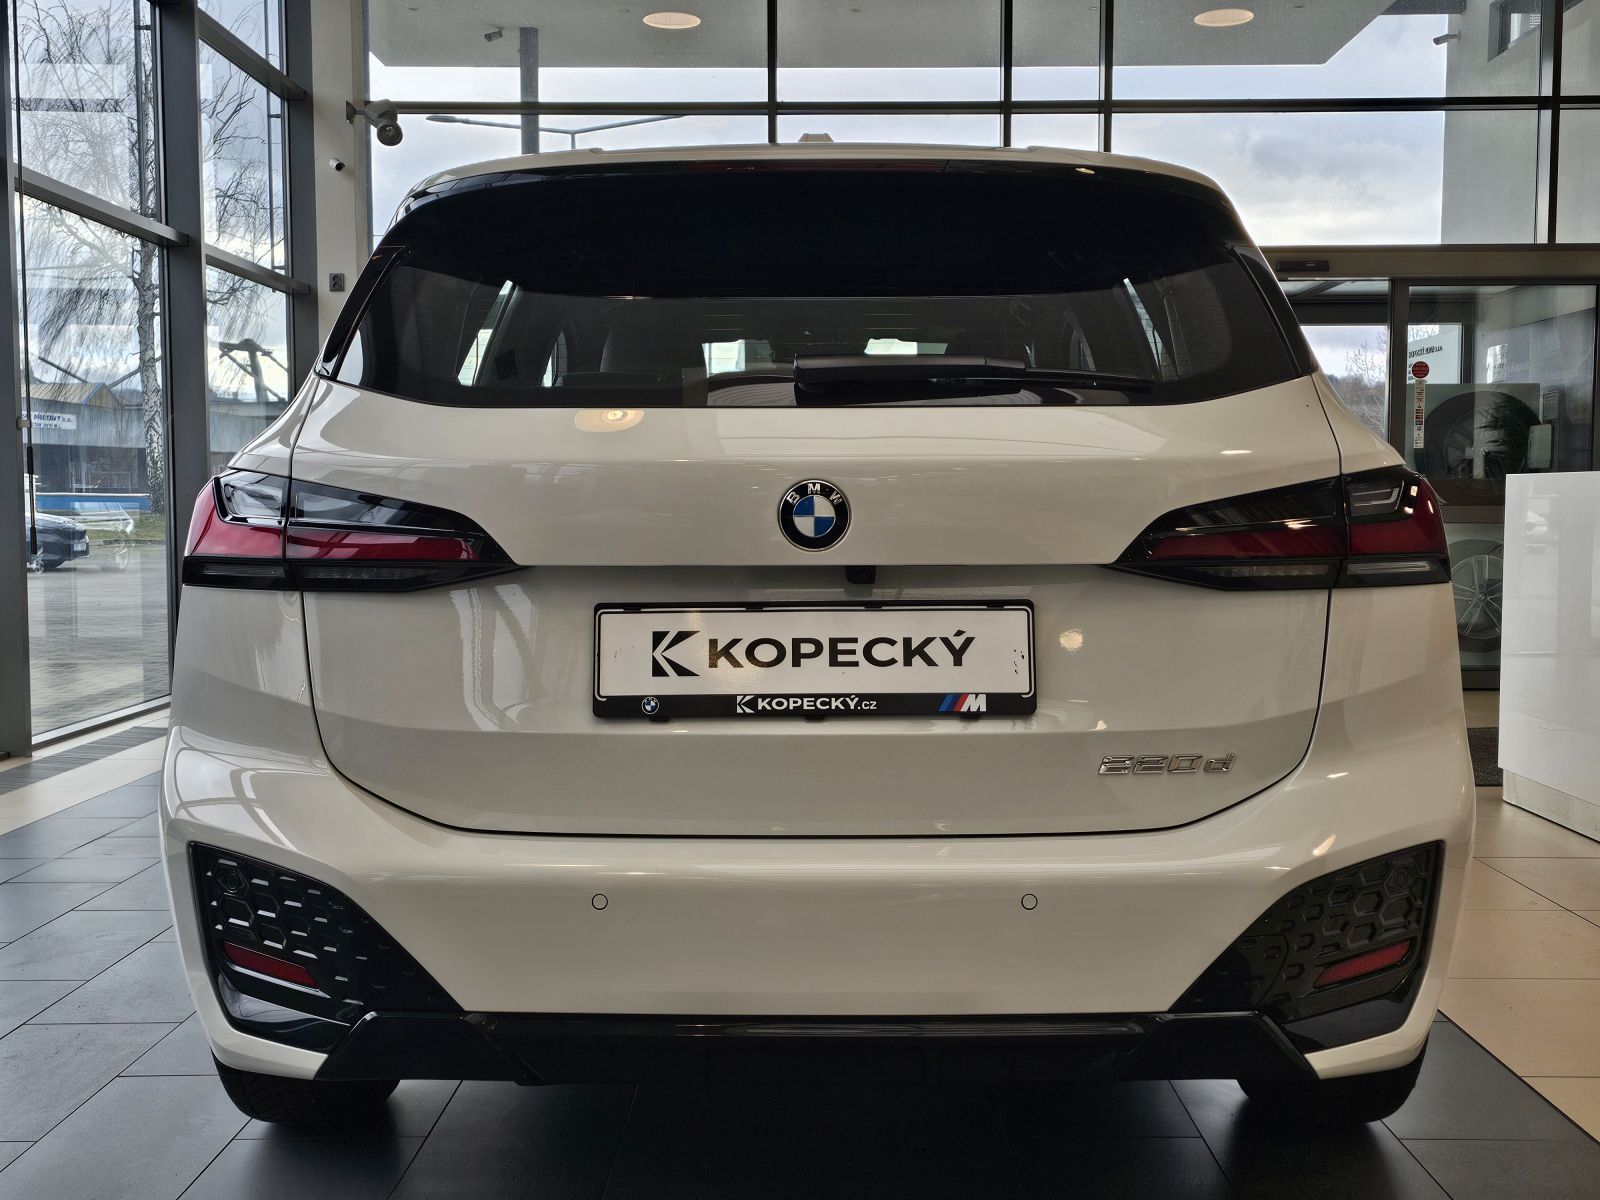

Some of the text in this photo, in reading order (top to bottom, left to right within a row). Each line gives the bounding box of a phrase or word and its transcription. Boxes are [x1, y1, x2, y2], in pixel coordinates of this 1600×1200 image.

[786, 483, 842, 506] BMW
[708, 629, 976, 668] KOPECKÝ
[1098, 753, 1236, 774] 220d
